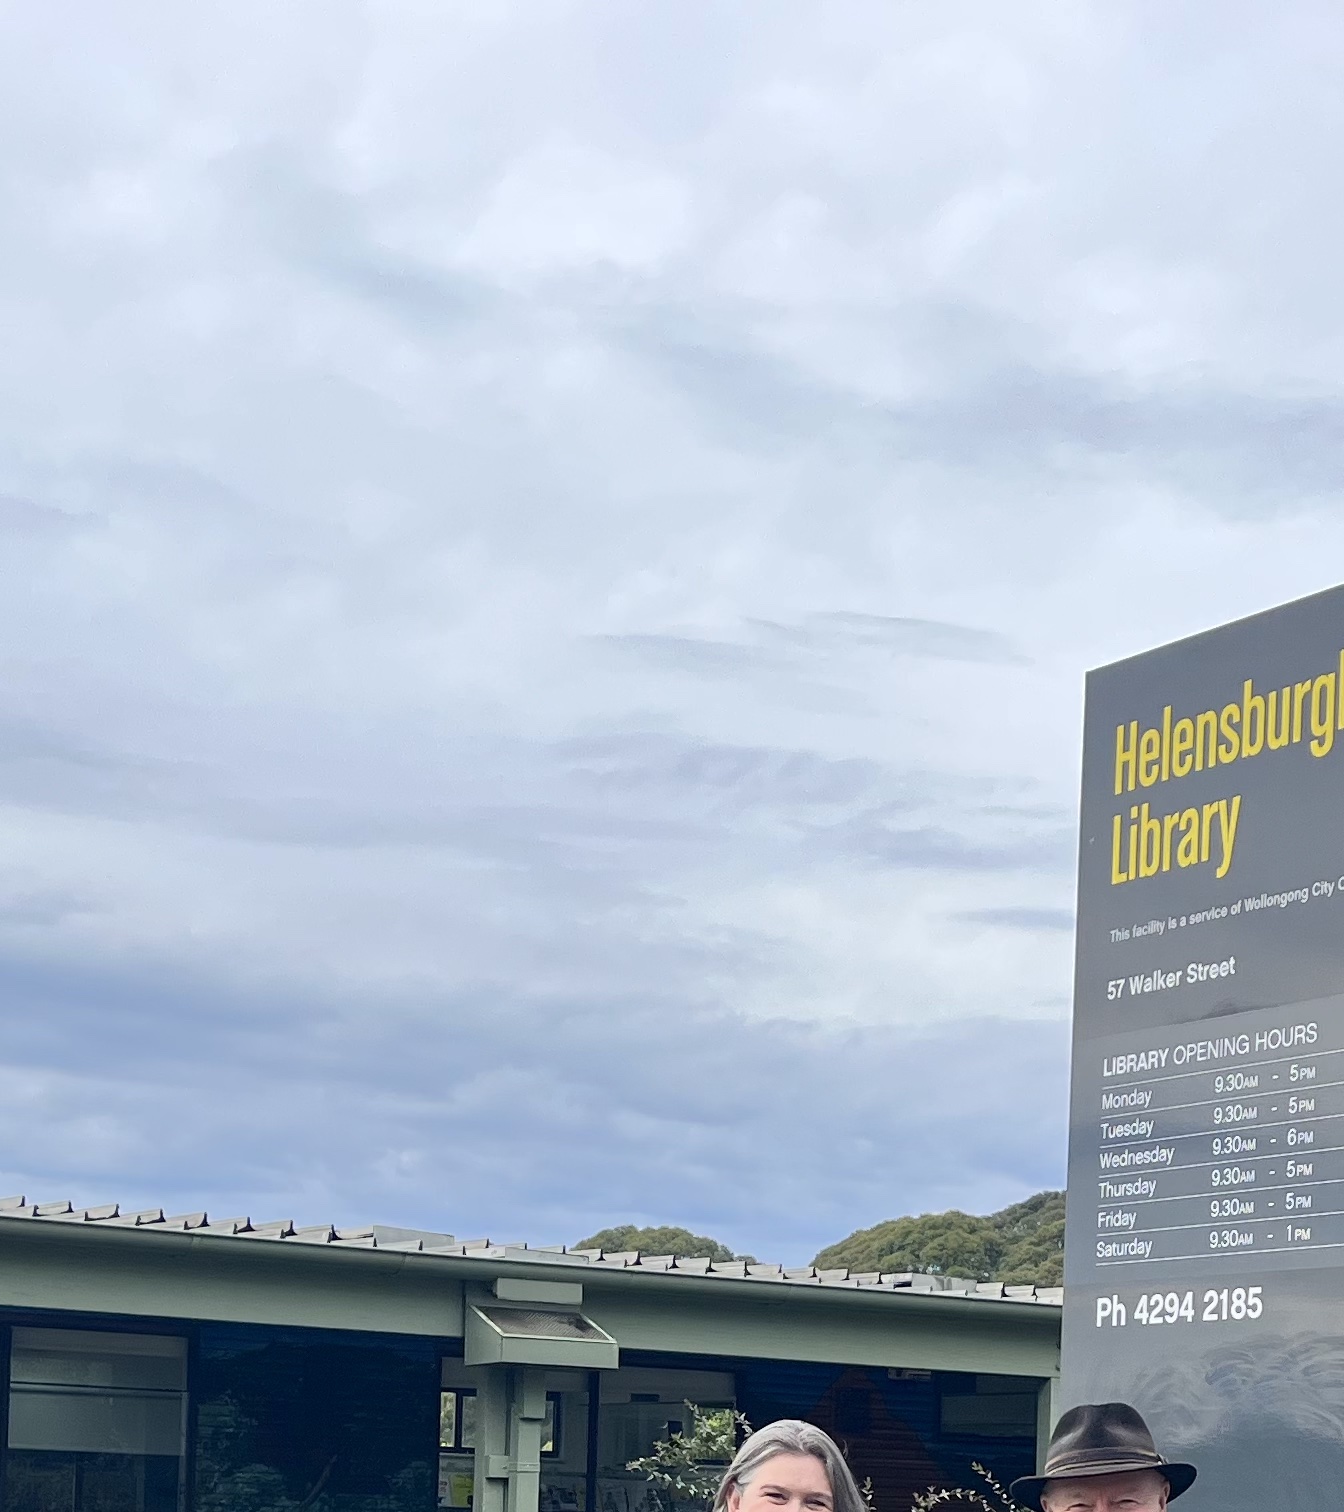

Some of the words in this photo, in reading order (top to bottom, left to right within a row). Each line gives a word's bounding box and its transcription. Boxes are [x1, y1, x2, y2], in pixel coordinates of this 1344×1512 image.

[1110, 795, 1241, 886] Library
[1110, 930, 1130, 942] This
[1132, 920, 1166, 937] facility
[1167, 917, 1177, 930] is
[1180, 917, 1186, 927] a
[1189, 906, 1227, 925] service
[1231, 900, 1243, 914] of
[1244, 886, 1309, 912] Wollongong
[1312, 880, 1335, 897] City
[1107, 979, 1125, 1001] 57
[1129, 965, 1182, 997] Walker
[1186, 956, 1236, 984] Street
[1103, 1048, 1168, 1077] LIBRARY
[1173, 1036, 1250, 1064] OPENING
[1255, 1022, 1318, 1051] HOURS
[1102, 1088, 1152, 1111] Monday
[1214, 1073, 1258, 1093] 9.30AM
[1290, 1065, 1316, 1081] 5PM
[1101, 1120, 1154, 1140] Tuesday
[1213, 1105, 1257, 1125] 9.30AM
[1289, 1097, 1315, 1114] 5PM
[1100, 1146, 1175, 1169] Wednesday
[1213, 1136, 1256, 1156] 9.30AM
[1287, 1129, 1314, 1146] 6PM
[1099, 1178, 1156, 1199] Thursday
[1211, 1168, 1256, 1187] 9.30AM
[1286, 1161, 1313, 1178] 5PM
[1098, 1211, 1137, 1229] Friday
[1210, 1200, 1254, 1218] 9.30AM
[1285, 1193, 1312, 1210] 5PM
[1096, 1238, 1153, 1259] Saturday
[1209, 1231, 1253, 1249] 9.30AM
[1286, 1225, 1311, 1242] 1PM
[1096, 1295, 1127, 1327] Ph
[1134, 1291, 1194, 1325] 4294
[1203, 1286, 1263, 1322] 2185
